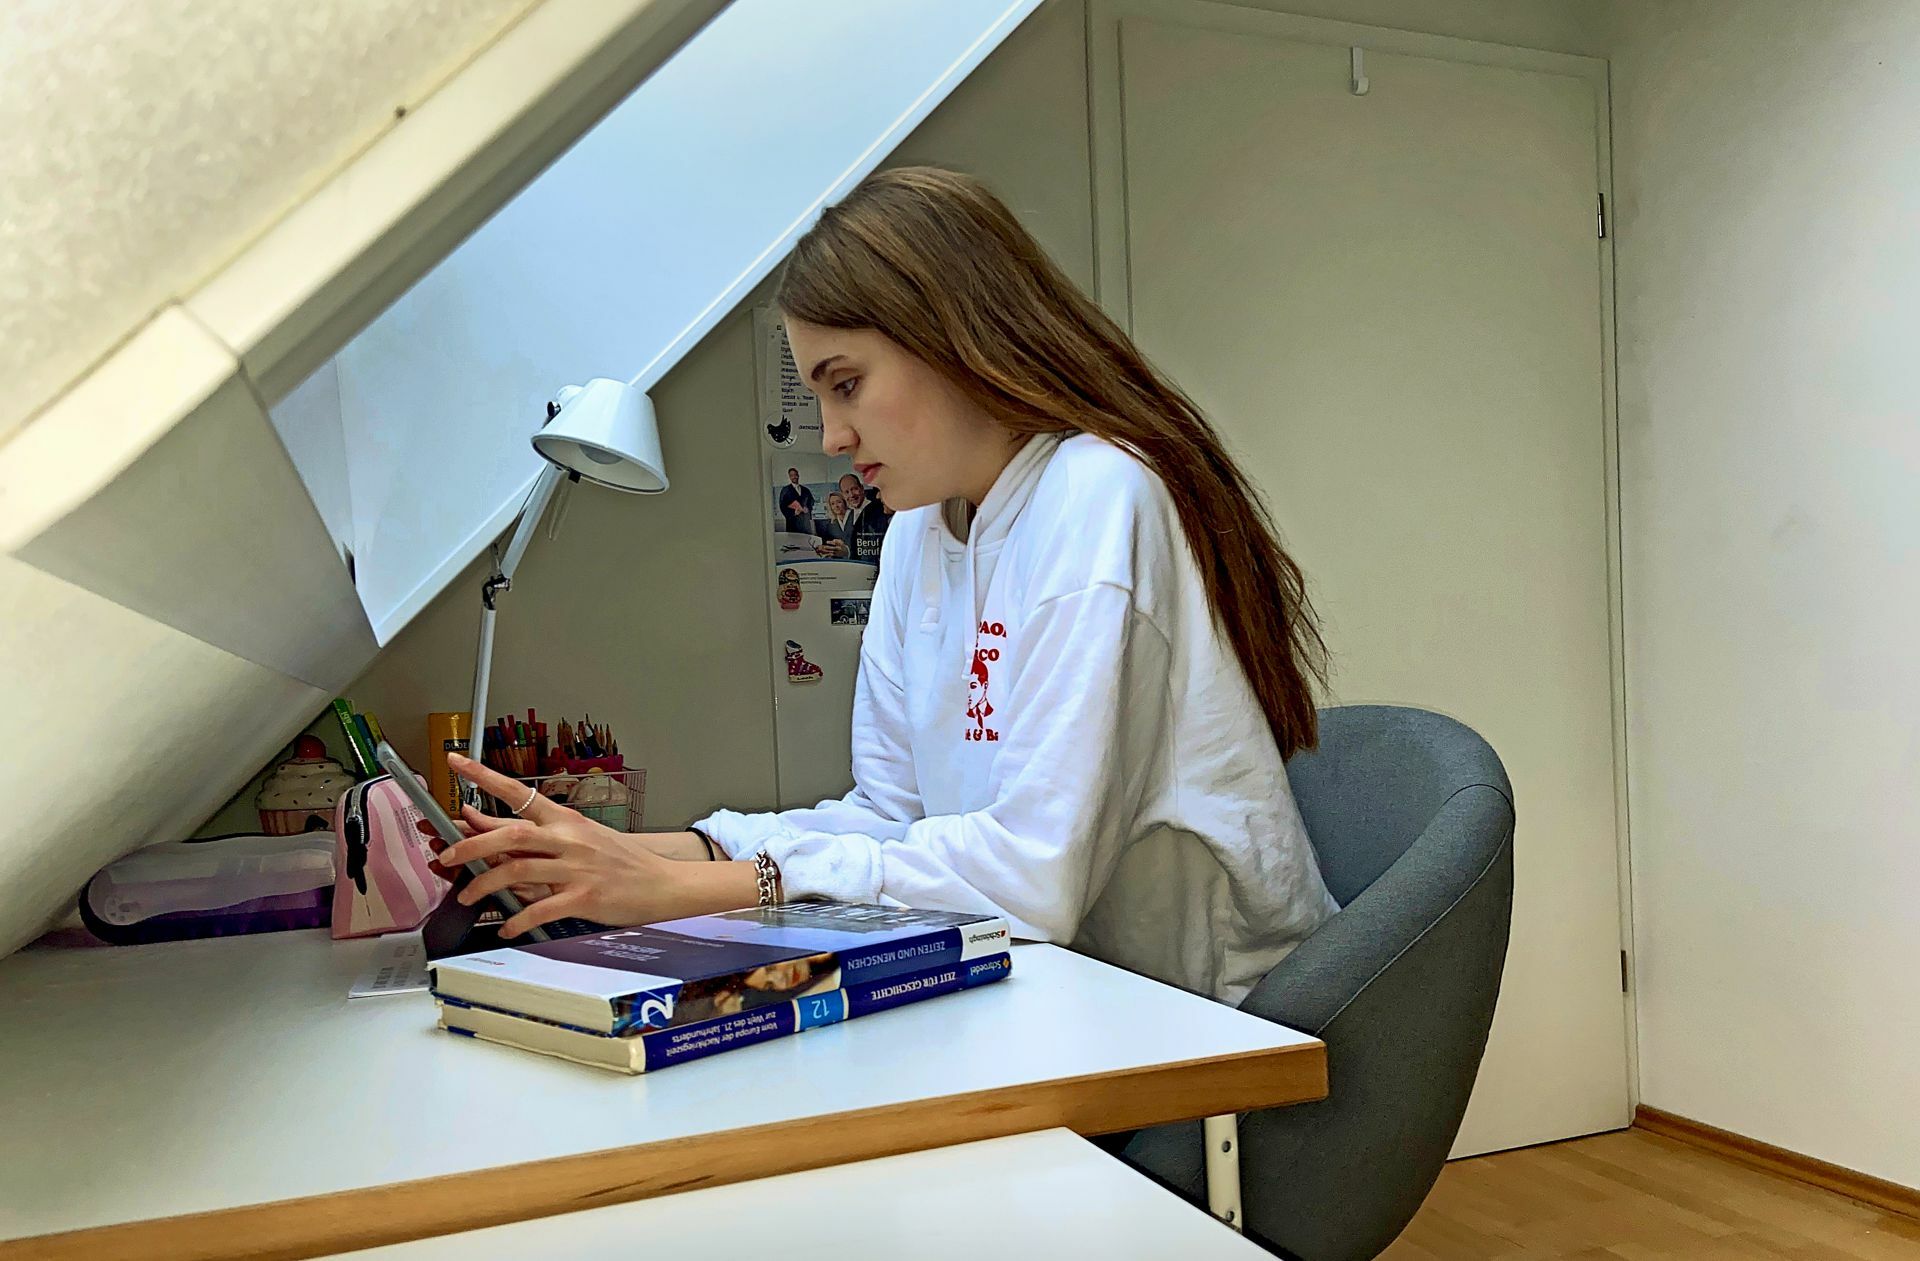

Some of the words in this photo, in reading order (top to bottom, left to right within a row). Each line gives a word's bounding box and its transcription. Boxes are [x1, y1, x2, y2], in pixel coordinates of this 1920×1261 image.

[445, 742, 470, 750] DUDE
[448, 767, 456, 798] deutsch
[897, 946, 918, 959] UND
[917, 941, 946, 954] ZEITEN
[847, 951, 896, 970] MENSCHEN
[970, 960, 1001, 976] Schroedel
[923, 974, 939, 988] FÜR
[939, 971, 956, 984] ZEIT
[871, 979, 922, 1001] GESCHICHTE
[641, 993, 674, 1025] 2
[763, 1011, 777, 1020] zur
[811, 999, 830, 1019] 12
[734, 1018, 747, 1028] des
[747, 1013, 764, 1024] Welt
[671, 1025, 721, 1043] Jahrhunderts
[735, 1024, 760, 1038] Europa
[760, 1022, 778, 1033] Vom
[721, 1033, 735, 1042] der
[666, 1036, 721, 1057] Nachkriegszeit
